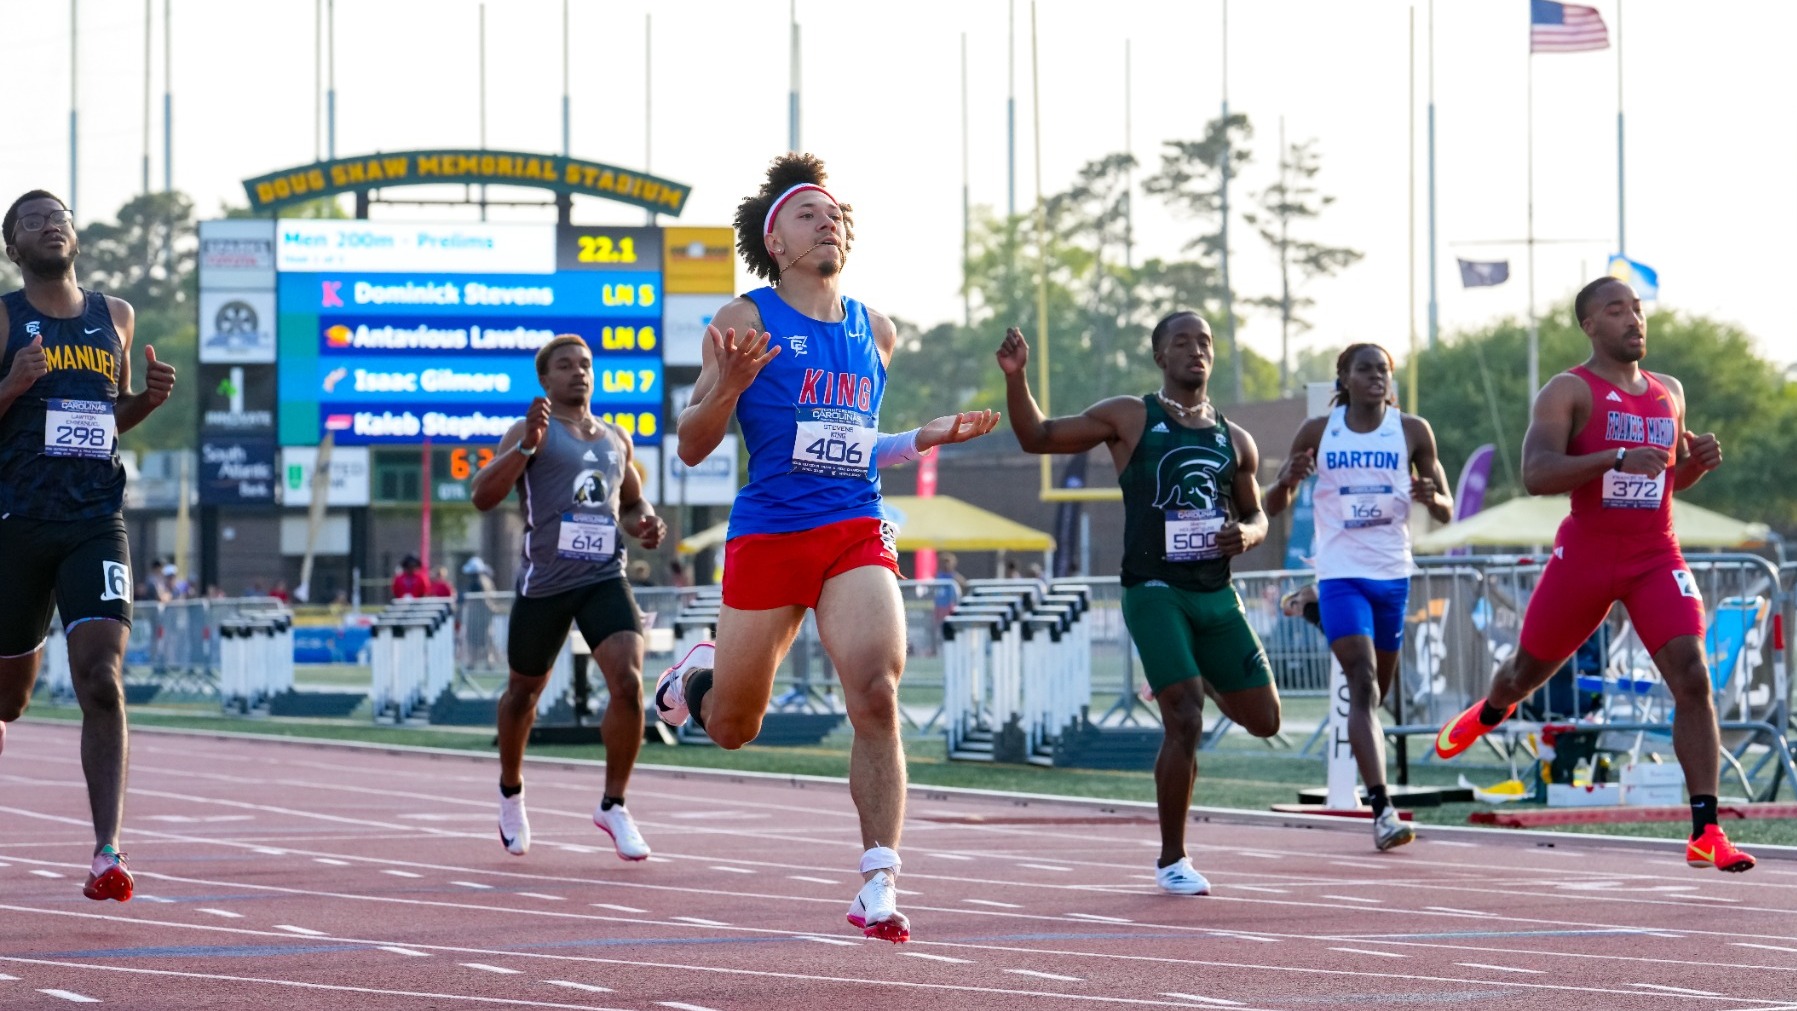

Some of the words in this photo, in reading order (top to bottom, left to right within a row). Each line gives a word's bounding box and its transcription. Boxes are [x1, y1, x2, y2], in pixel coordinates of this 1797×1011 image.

[256, 169, 325, 204] DOUG
[330, 157, 408, 186] SHAW
[416, 154, 558, 181] MEMORIAL
[564, 162, 683, 209] STADIUM
[284, 232, 328, 247] Men
[336, 231, 395, 248] 200m
[417, 231, 494, 249] Prelims
[577, 236, 637, 263] 22.1
[354, 281, 460, 304] Dominick
[464, 281, 554, 306] Stevens
[602, 284, 635, 306] LN
[638, 284, 655, 306] 5
[353, 324, 468, 349] Antavious
[470, 325, 556, 349] Lawton
[602, 326, 635, 349] LN
[637, 326, 656, 350] 6
[42, 344, 115, 384] MANUEL
[354, 369, 418, 392] Isaac
[420, 368, 511, 392] Gilmore
[602, 370, 635, 392] LN
[638, 370, 655, 392] 7
[798, 368, 871, 412] KING
[353, 412, 420, 436] Kaleb
[422, 411, 527, 440] Stephen
[637, 412, 656, 436] 8
[1606, 411, 1645, 443] FRANCIS
[56, 426, 105, 447] 298
[202, 443, 247, 463] South
[806, 438, 862, 464] 406
[1326, 451, 1399, 470] BARTON
[1612, 481, 1658, 498] 372
[1352, 504, 1382, 518] 166
[572, 536, 603, 551] 614
[1173, 532, 1218, 549] 500
[108, 565, 125, 596] 6
